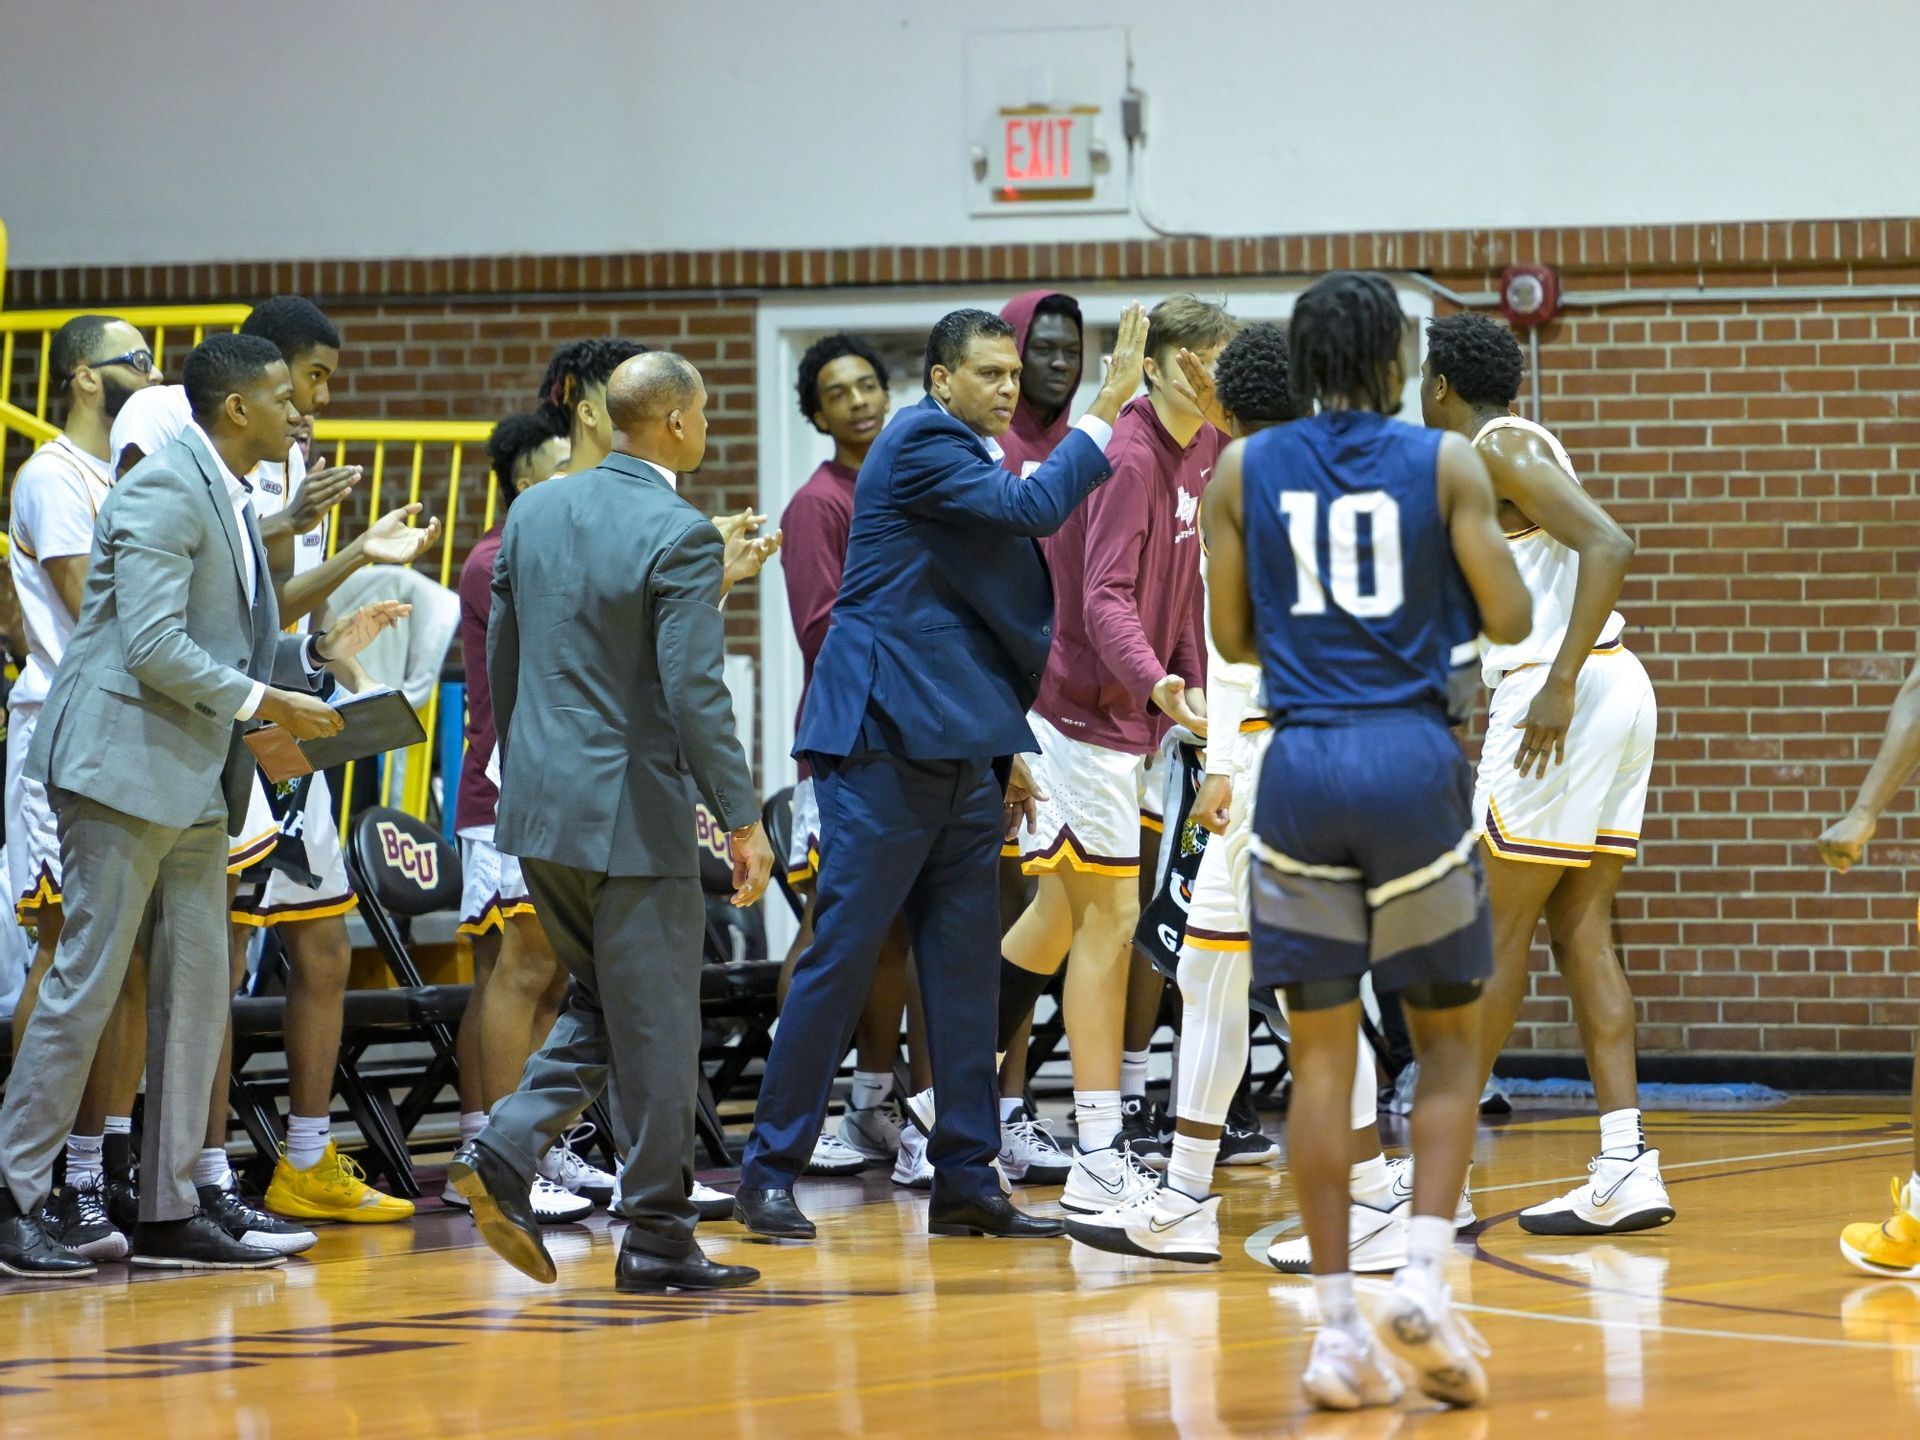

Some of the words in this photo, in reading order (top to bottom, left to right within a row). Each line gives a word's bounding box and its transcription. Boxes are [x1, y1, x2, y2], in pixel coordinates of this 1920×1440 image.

[1006, 119, 1073, 179] EXIT
[1280, 490, 1404, 618] 10
[378, 823, 437, 887] BCU
